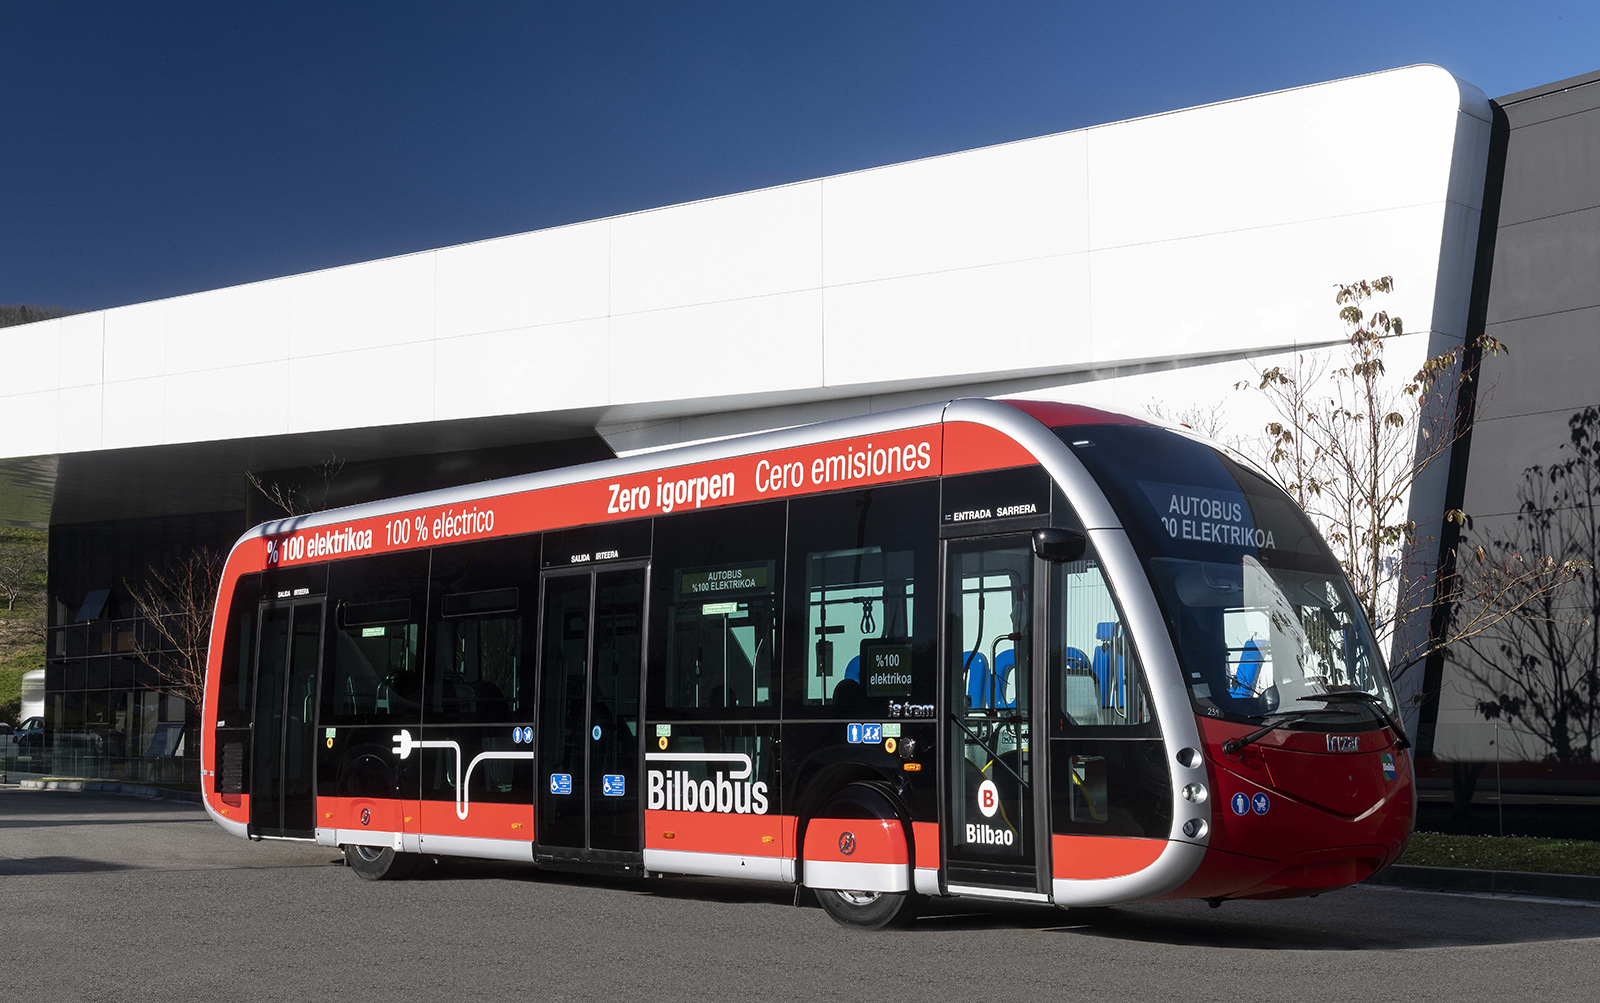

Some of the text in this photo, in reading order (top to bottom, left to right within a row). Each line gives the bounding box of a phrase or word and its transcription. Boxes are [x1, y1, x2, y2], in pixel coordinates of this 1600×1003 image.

[755, 442, 931, 493] Cero emisiones
[607, 471, 735, 514] Zero igorpen
[953, 503, 1037, 522] ENTRADA SARRERA
[1168, 494, 1243, 523] AUTOBUS
[385, 506, 495, 546] 100 % eléctrico
[1182, 519, 1276, 550] ELEKTRIKOA
[266, 526, 373, 565] % 100 elektrikoa
[571, 550, 619, 563] SALIDA IRTEERA
[692, 578, 756, 593] %100 ELEKTRIKOA
[707, 569, 743, 581] AUTOBUS
[875, 654, 900, 667] %100
[870, 672, 912, 685] elektrikoa
[903, 701, 934, 717] tram
[647, 769, 769, 815] Bilbobus
[983, 789, 994, 808] B
[966, 823, 1014, 846] Bilbao
